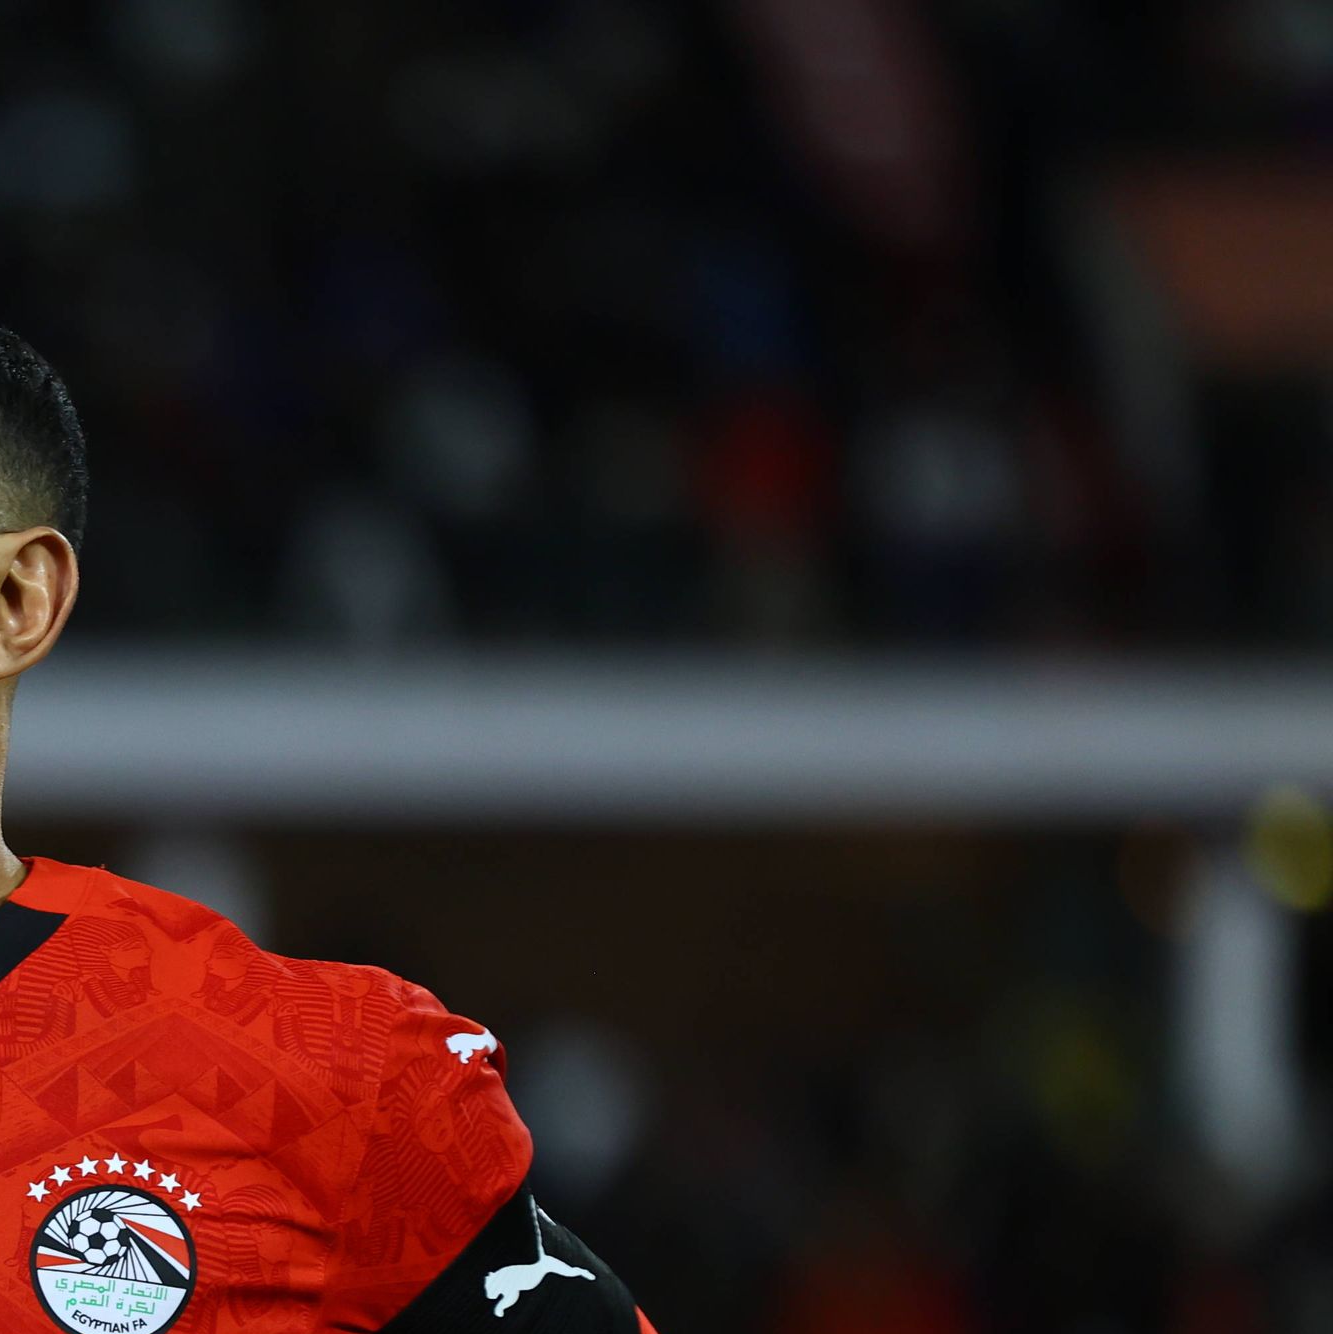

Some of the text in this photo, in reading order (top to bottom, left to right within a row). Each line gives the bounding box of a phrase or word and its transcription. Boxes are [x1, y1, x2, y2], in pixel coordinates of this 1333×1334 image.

[55, 1277, 168, 1301] الاتحاد المصري
[65, 1294, 156, 1317] لكرة القدم
[71, 1309, 148, 1333] EGYPTIAN FA
